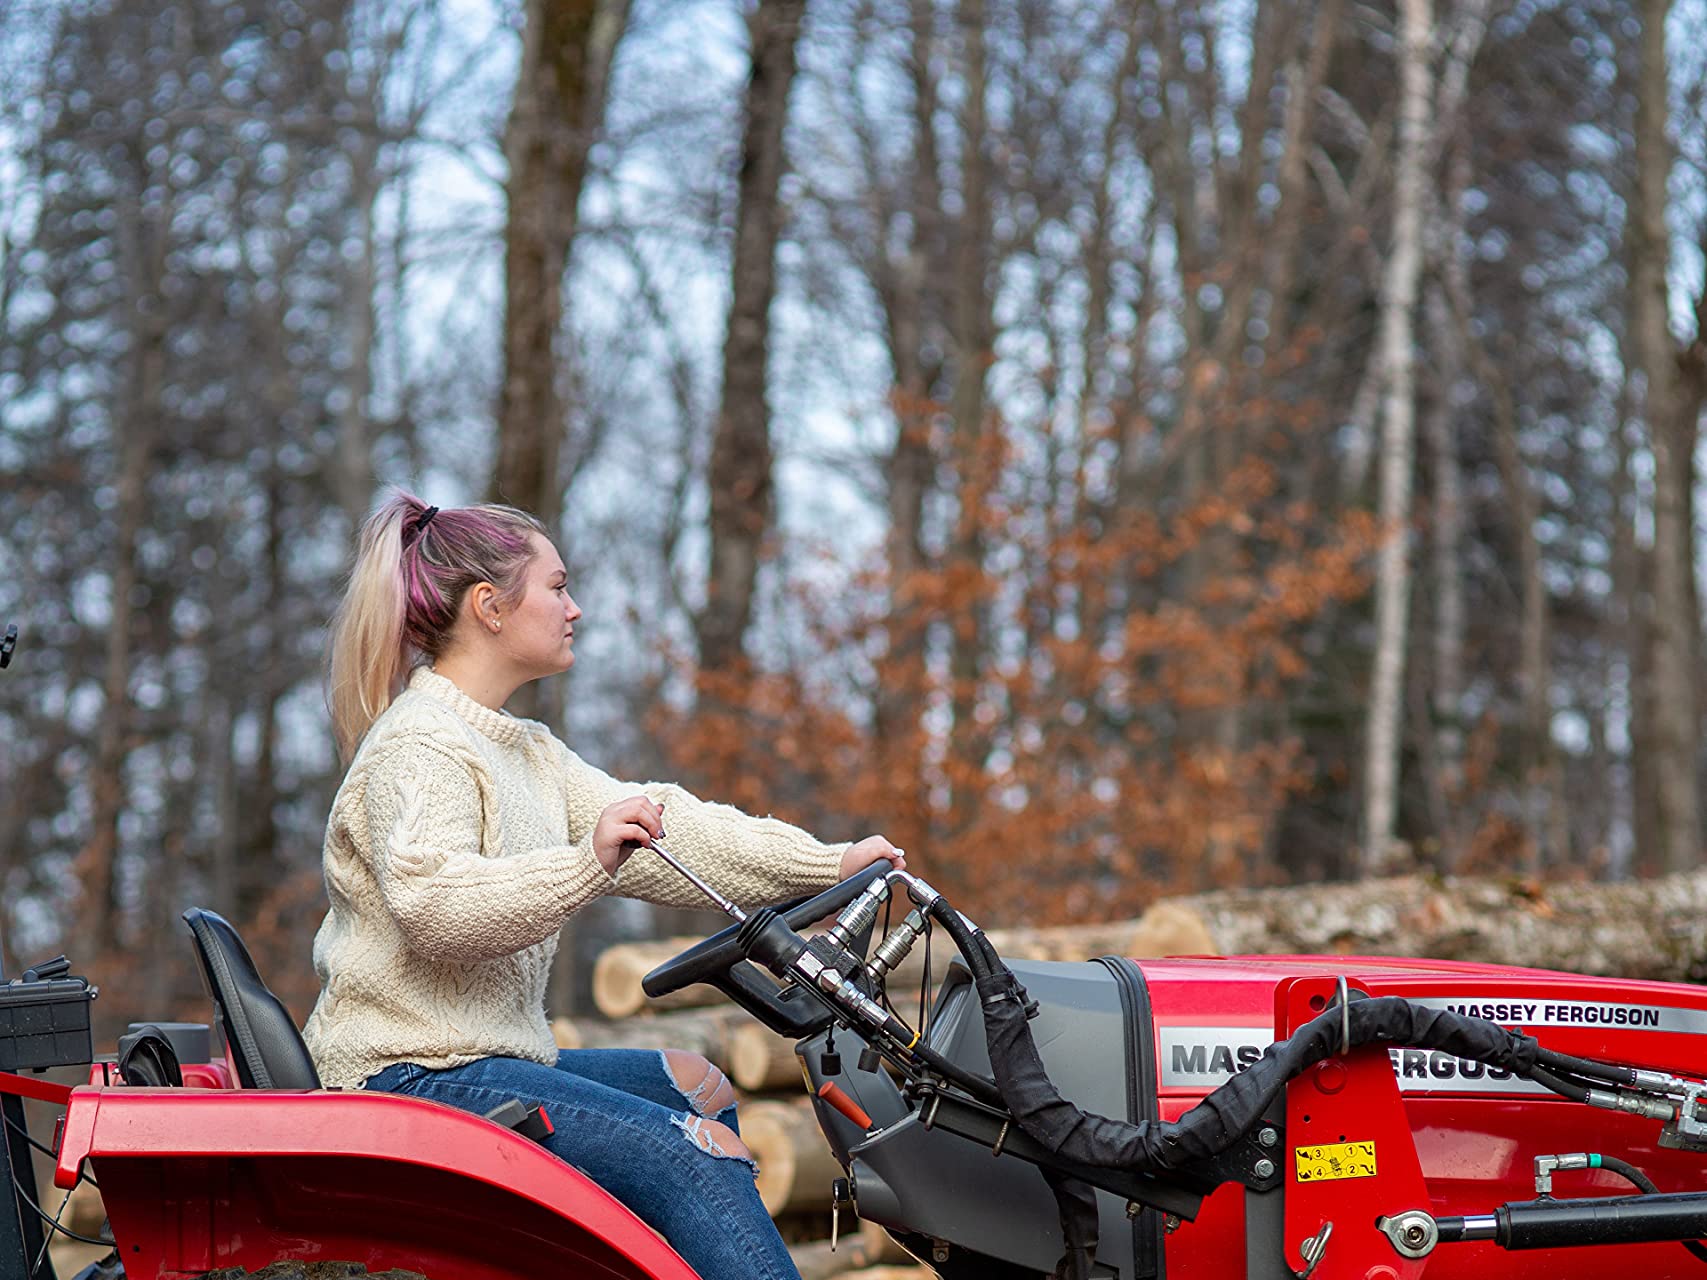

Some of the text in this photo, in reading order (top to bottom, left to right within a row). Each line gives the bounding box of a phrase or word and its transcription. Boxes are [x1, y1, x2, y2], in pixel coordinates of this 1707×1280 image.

[1447, 1004, 1659, 1026] MASSEY FERGUSON
[1171, 1044, 1270, 1074] MAS
